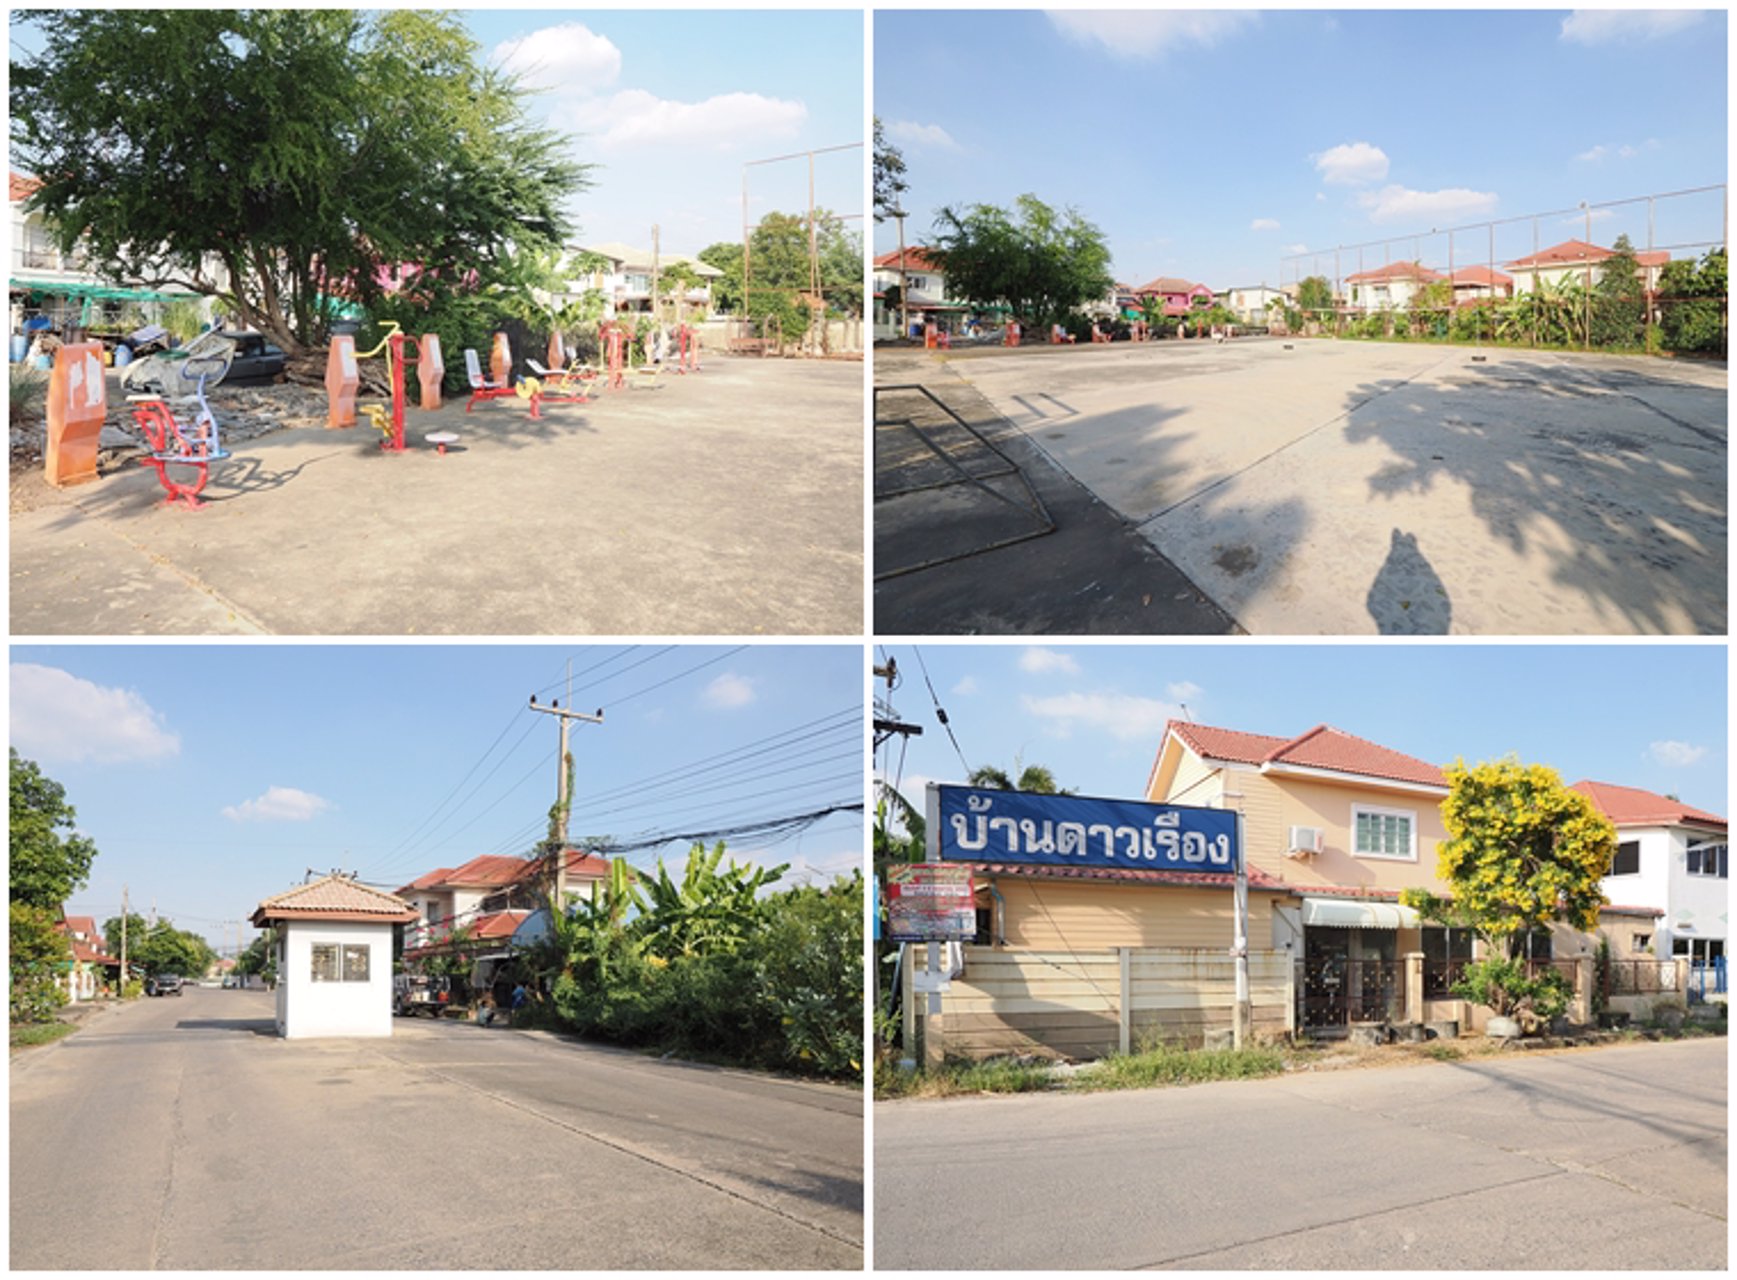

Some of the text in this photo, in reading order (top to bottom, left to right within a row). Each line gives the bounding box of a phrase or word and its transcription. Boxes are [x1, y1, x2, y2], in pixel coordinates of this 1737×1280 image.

[950, 795, 1230, 865] บ้านดาวเรือง
